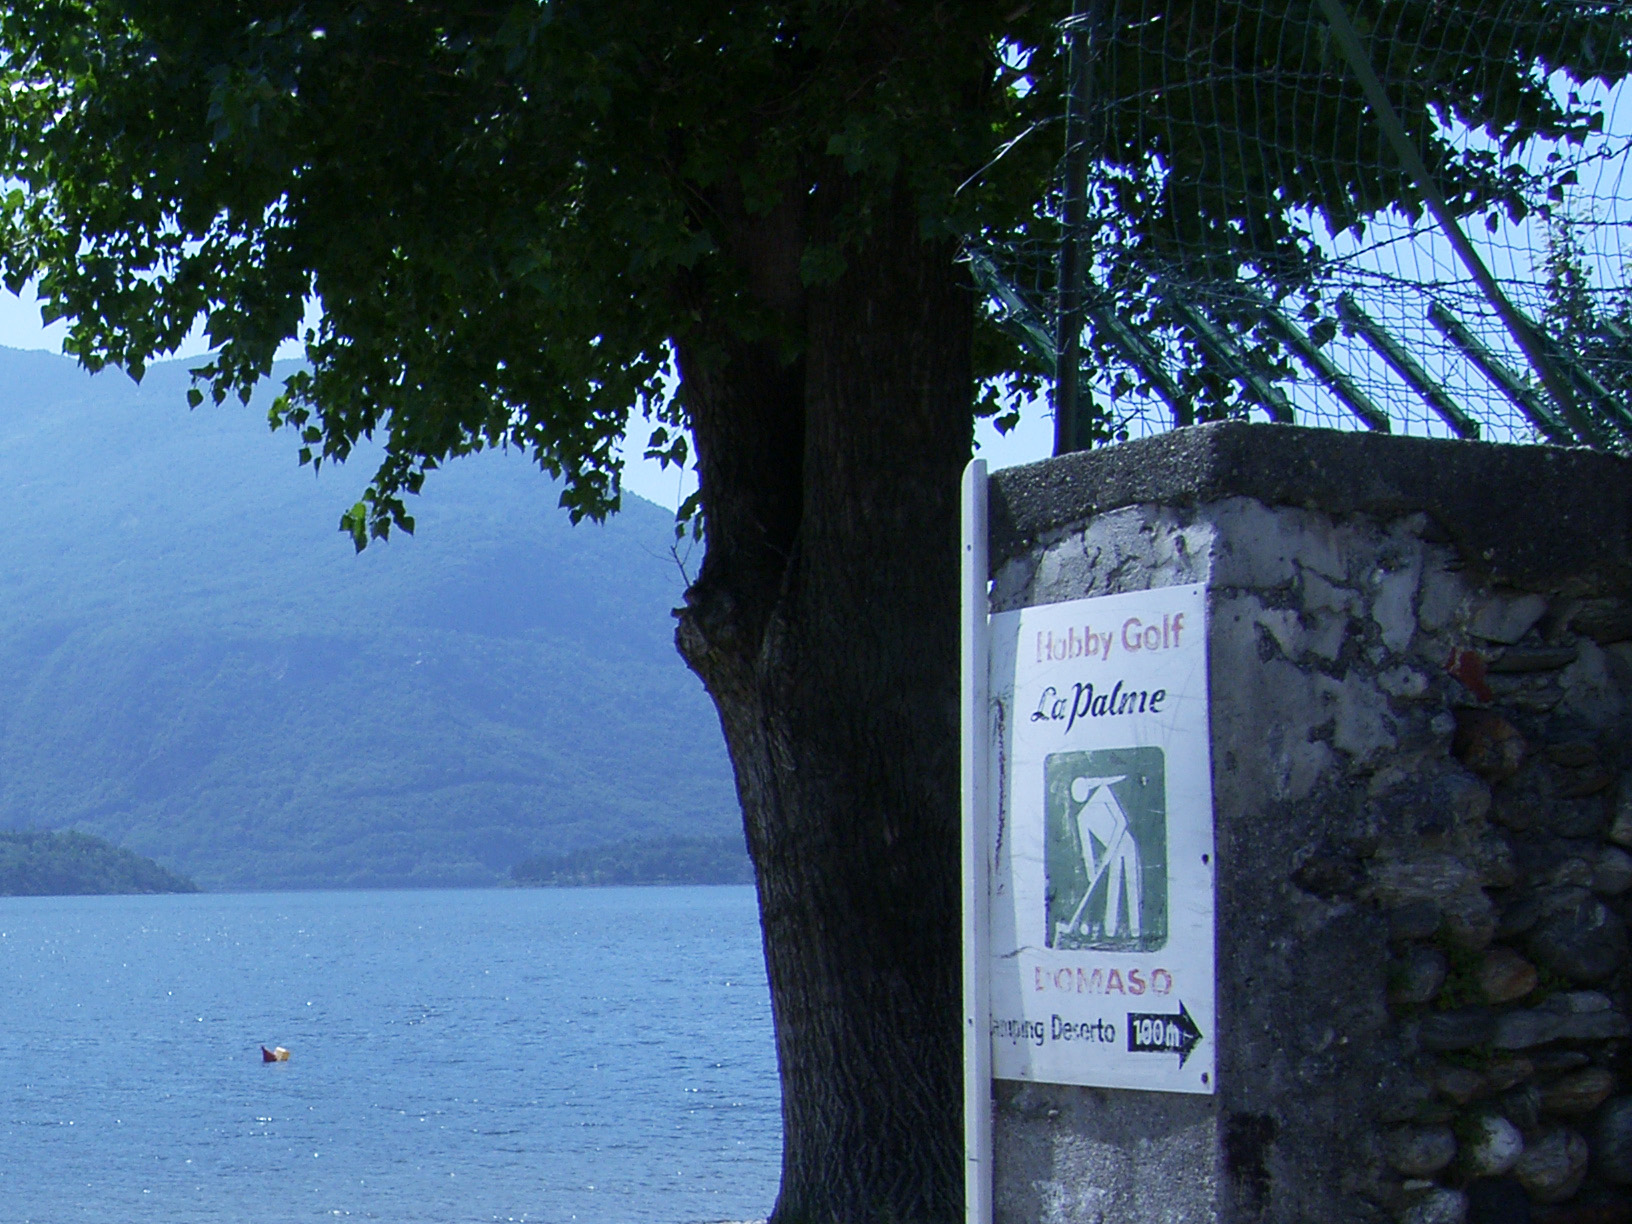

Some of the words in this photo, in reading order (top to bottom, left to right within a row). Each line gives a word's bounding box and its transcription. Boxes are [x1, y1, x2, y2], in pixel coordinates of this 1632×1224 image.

[1036, 625, 1113, 662] Hobby
[1121, 612, 1184, 652] Golf
[1065, 679, 1166, 735] Palme
